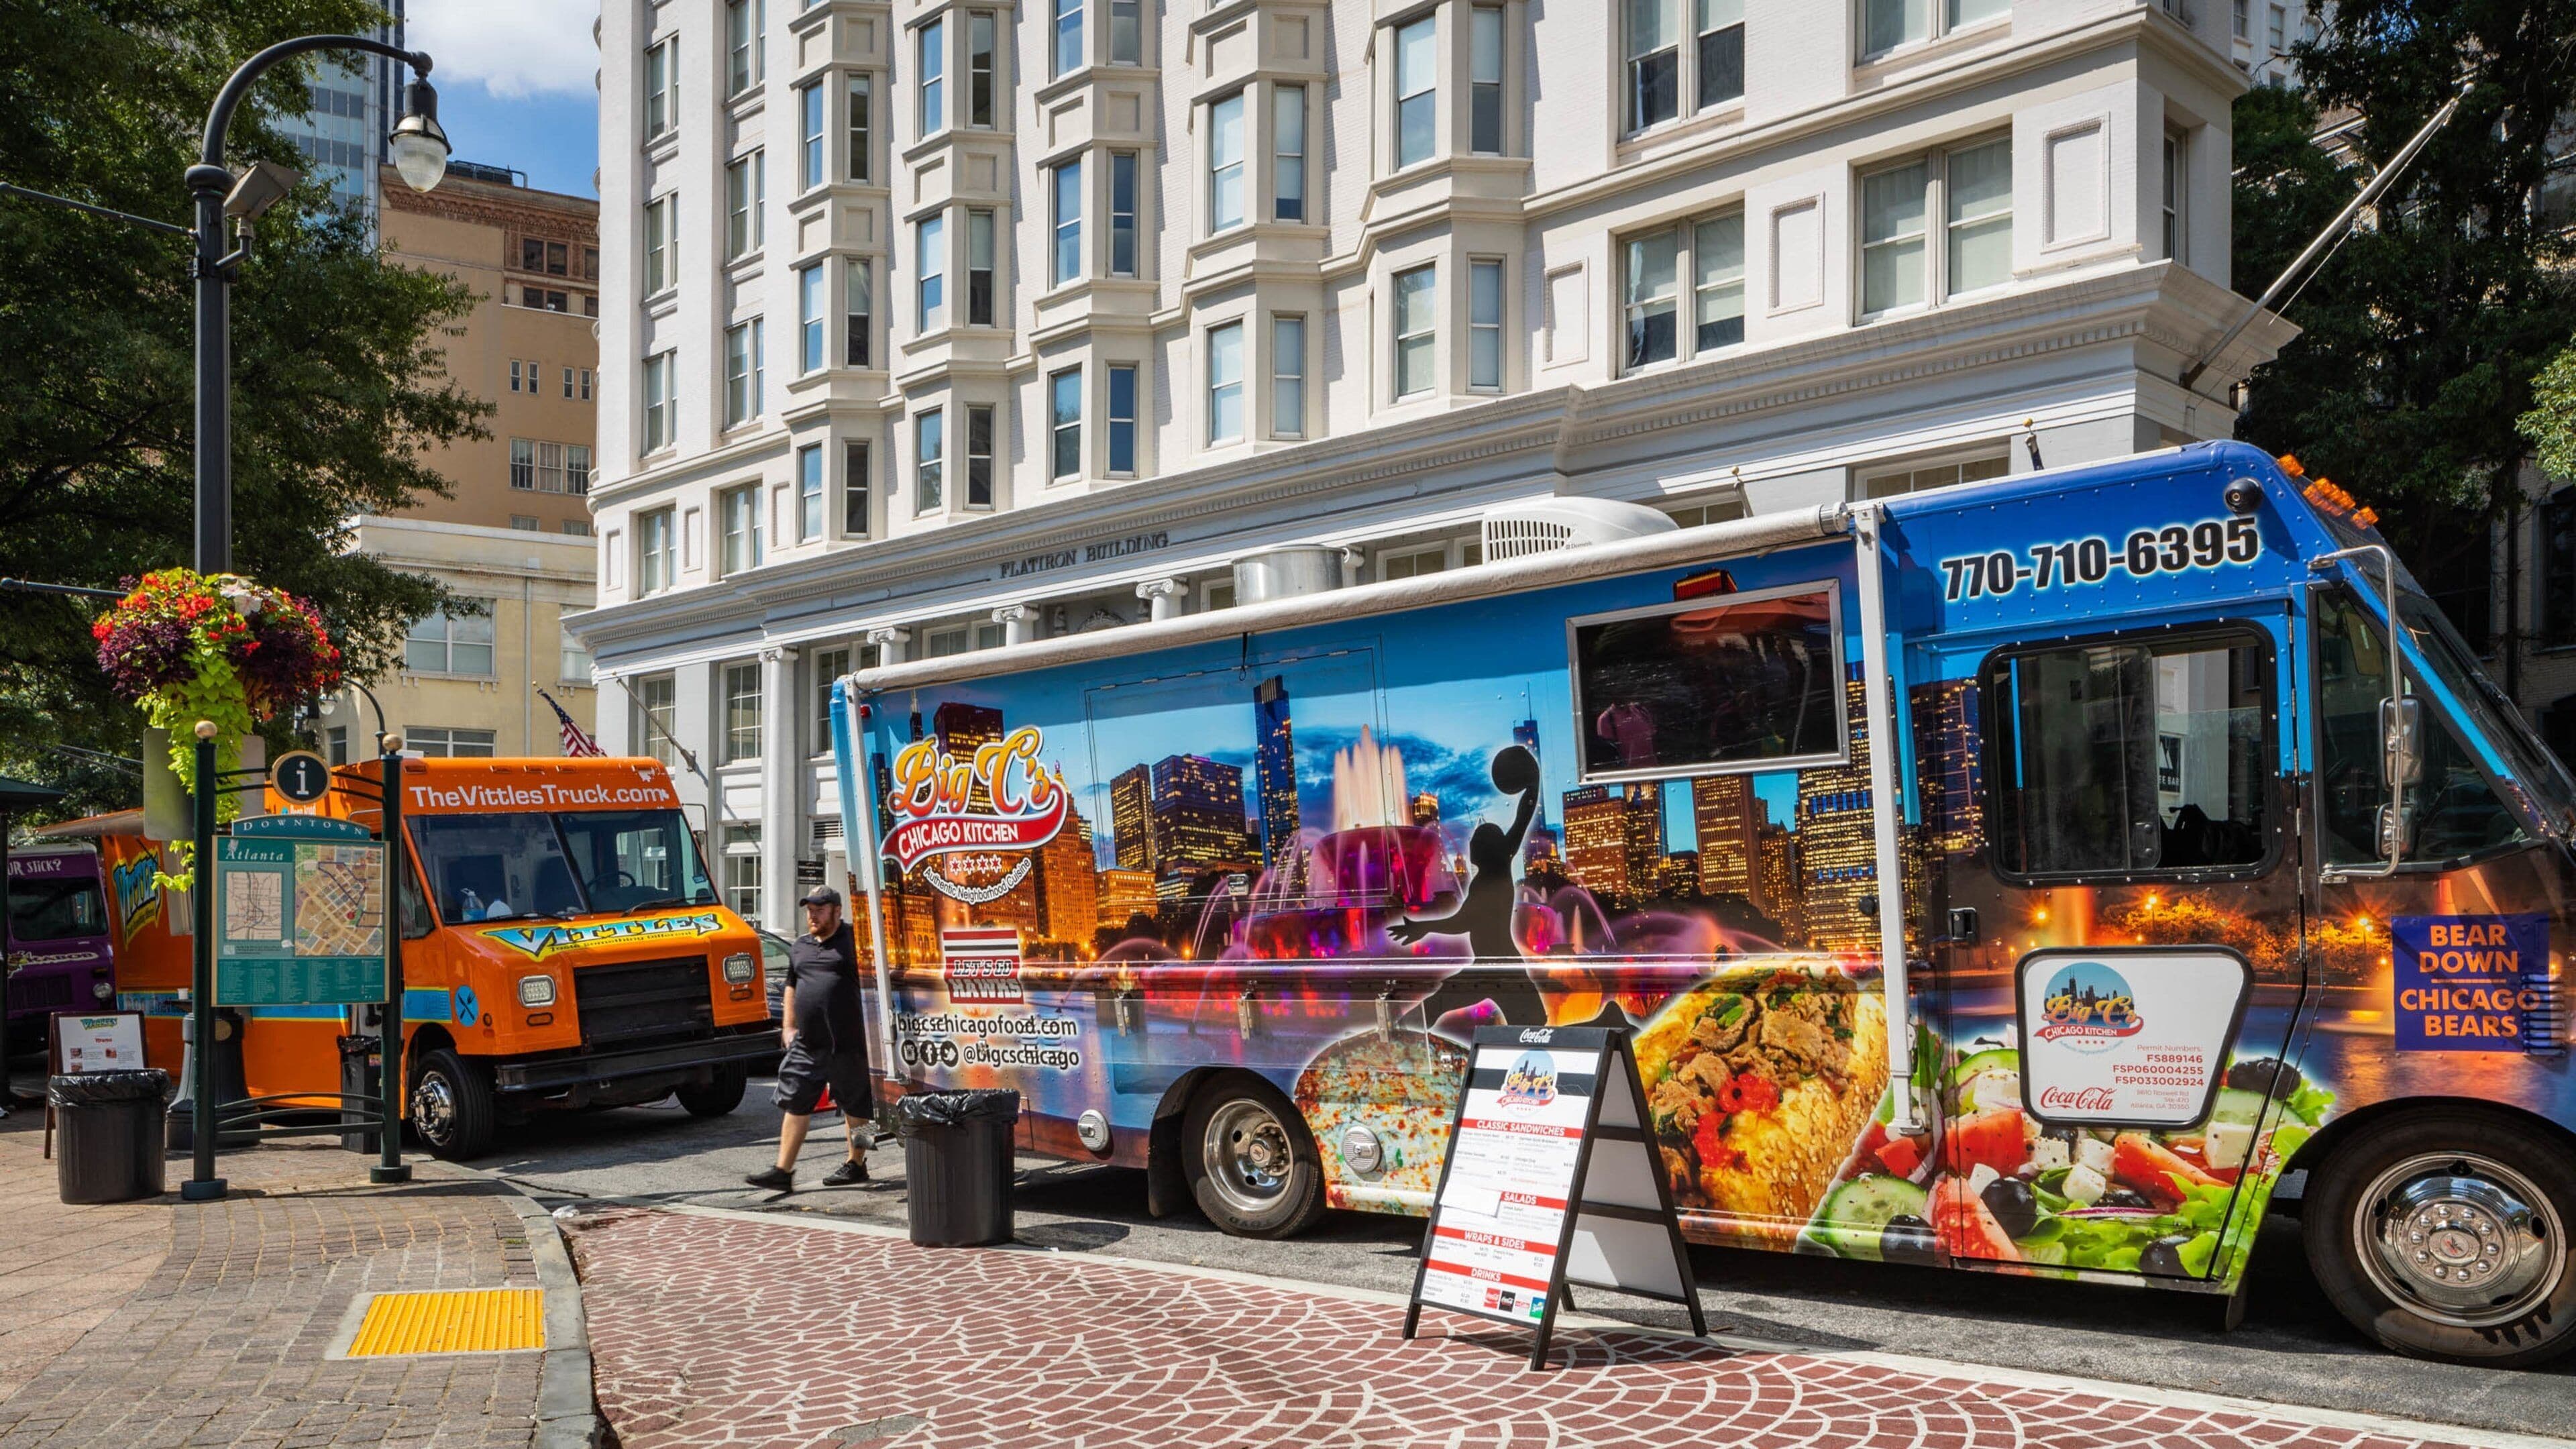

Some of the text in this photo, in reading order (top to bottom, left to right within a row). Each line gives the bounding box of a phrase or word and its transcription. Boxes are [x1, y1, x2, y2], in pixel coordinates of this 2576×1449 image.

[1000, 531, 1169, 578] FLATIRON BUILDING
[1942, 517, 2259, 600] 770-710-6395
[888, 728, 1051, 818] Big C's
[409, 784, 664, 808] TheVittlesTruck.com
[244, 819, 362, 835] DOWNTOWN
[898, 821, 1019, 859] CHICAGO KITCHEN
[225, 847, 284, 861] Atlanta
[924, 858, 1030, 902] Authentic Neighborhood Cuisine
[483, 914, 721, 957] VITTLES
[2430, 924, 2506, 947] BEAR
[953, 959, 1012, 976] LET'S GO
[2420, 951, 2518, 973] DOWN
[2041, 994, 2093, 1024] Big
[2400, 989, 2540, 1011] CHICAGO
[898, 1014, 1077, 1038] bigcschicagofood.com
[1519, 1028, 1554, 1043] Coca-Cola
[2045, 1026, 2117, 1039] CHICAGO KITCHEN
[2424, 1015, 2518, 1037] BEARS
[963, 1042, 1079, 1070] @bigcschicago
[2147, 1055, 2203, 1063] FS889146
[2113, 1065, 2204, 1074] FSP060004255
[2115, 1077, 2204, 1086] FSP033002924
[2041, 1086, 2117, 1110] Coca-Cola
[1477, 1120, 1509, 1131] CLASSIC
[1509, 1122, 1565, 1136] SANDWICHES
[1504, 1192, 1537, 1205] SALADS
[1464, 1230, 1493, 1245] WRAPS
[1494, 1236, 1500, 1246] &
[1502, 1238, 1526, 1250] SIDES
[1470, 1267, 1501, 1282] DRINKS
